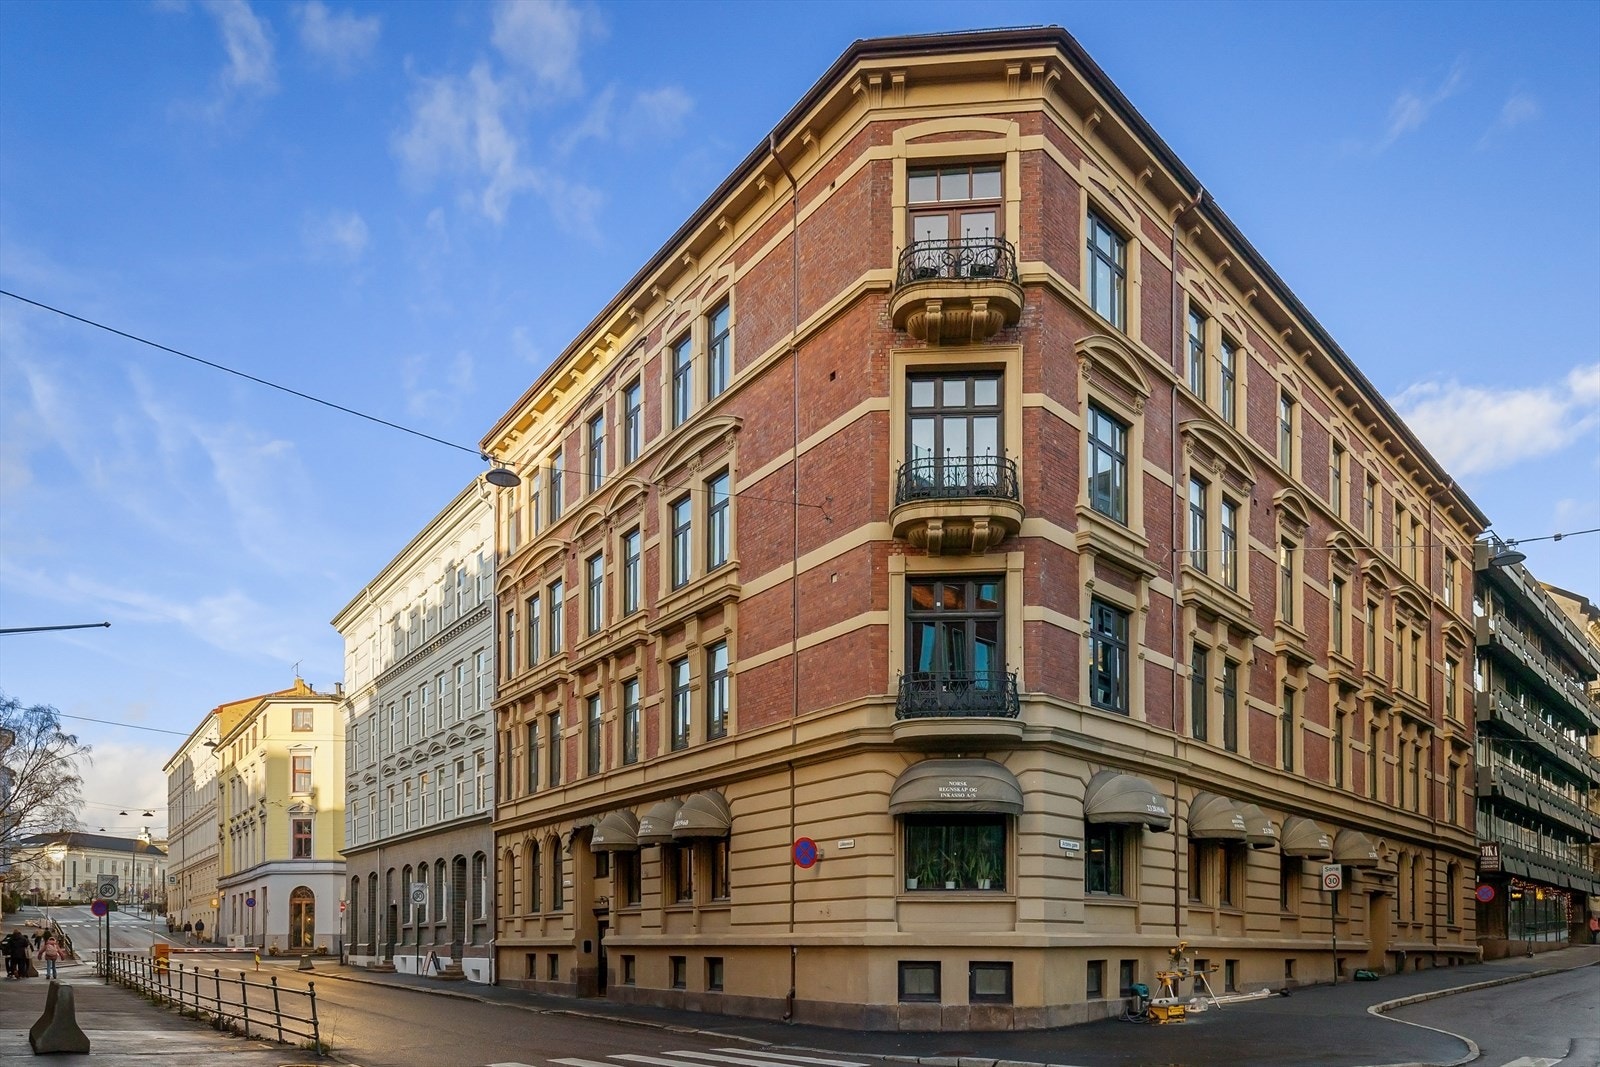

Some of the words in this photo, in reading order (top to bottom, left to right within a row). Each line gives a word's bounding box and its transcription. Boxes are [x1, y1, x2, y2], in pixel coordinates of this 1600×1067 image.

[1481, 846, 1498, 857] VIKA
[1328, 877, 1338, 885] 30
[103, 886, 114, 894] 30
